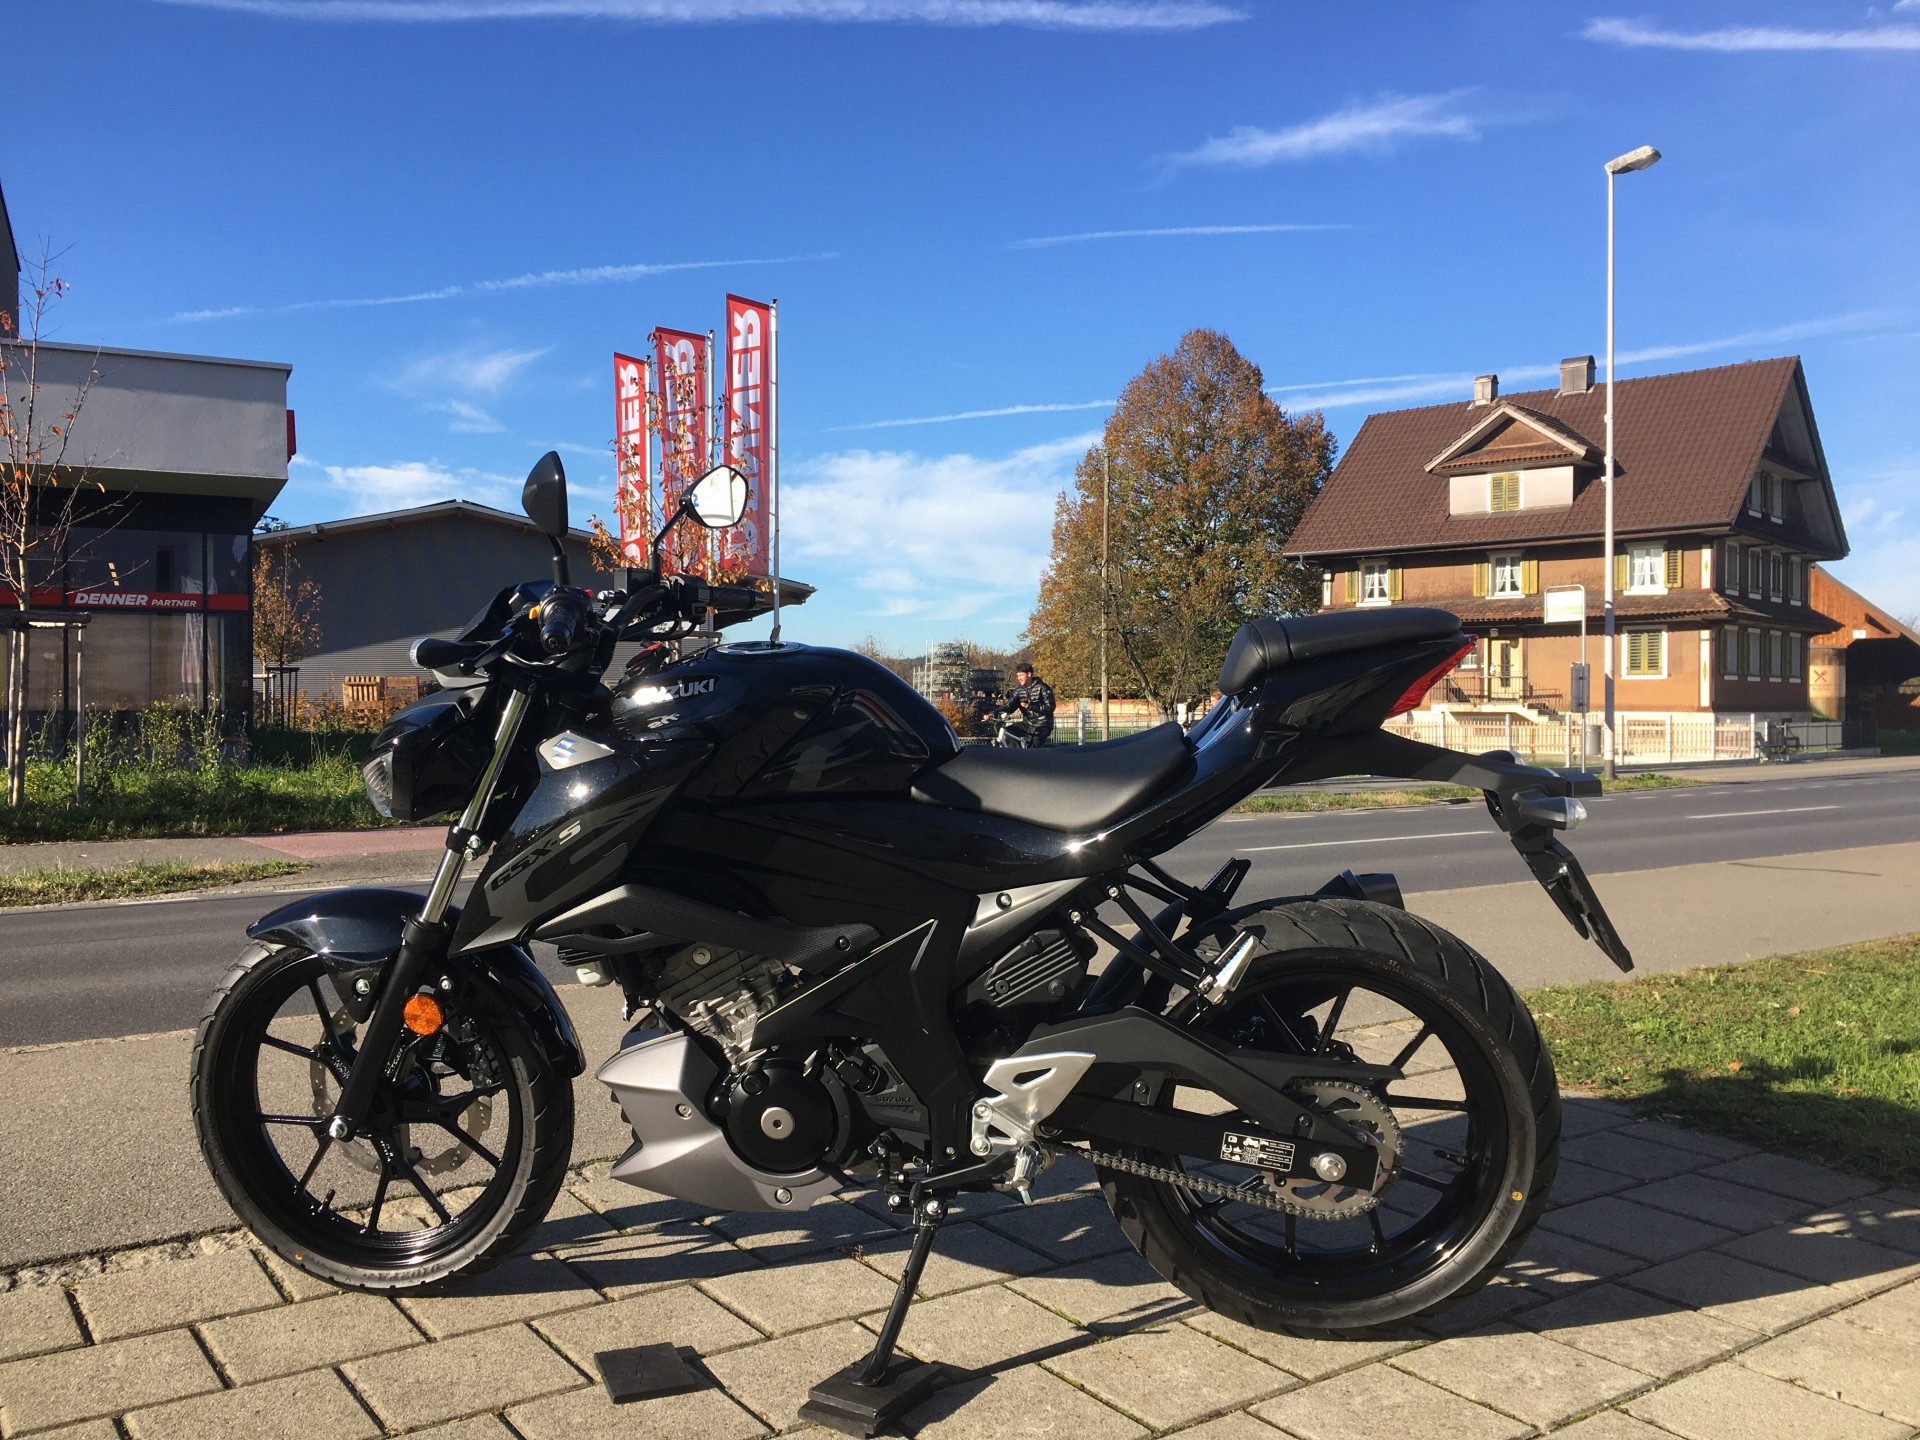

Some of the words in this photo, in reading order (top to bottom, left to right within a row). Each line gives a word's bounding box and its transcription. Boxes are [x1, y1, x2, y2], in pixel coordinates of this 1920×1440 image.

[75, 593, 149, 606] DENNER
[151, 599, 197, 607] PARTNER
[490, 820, 582, 892] GSX-S
